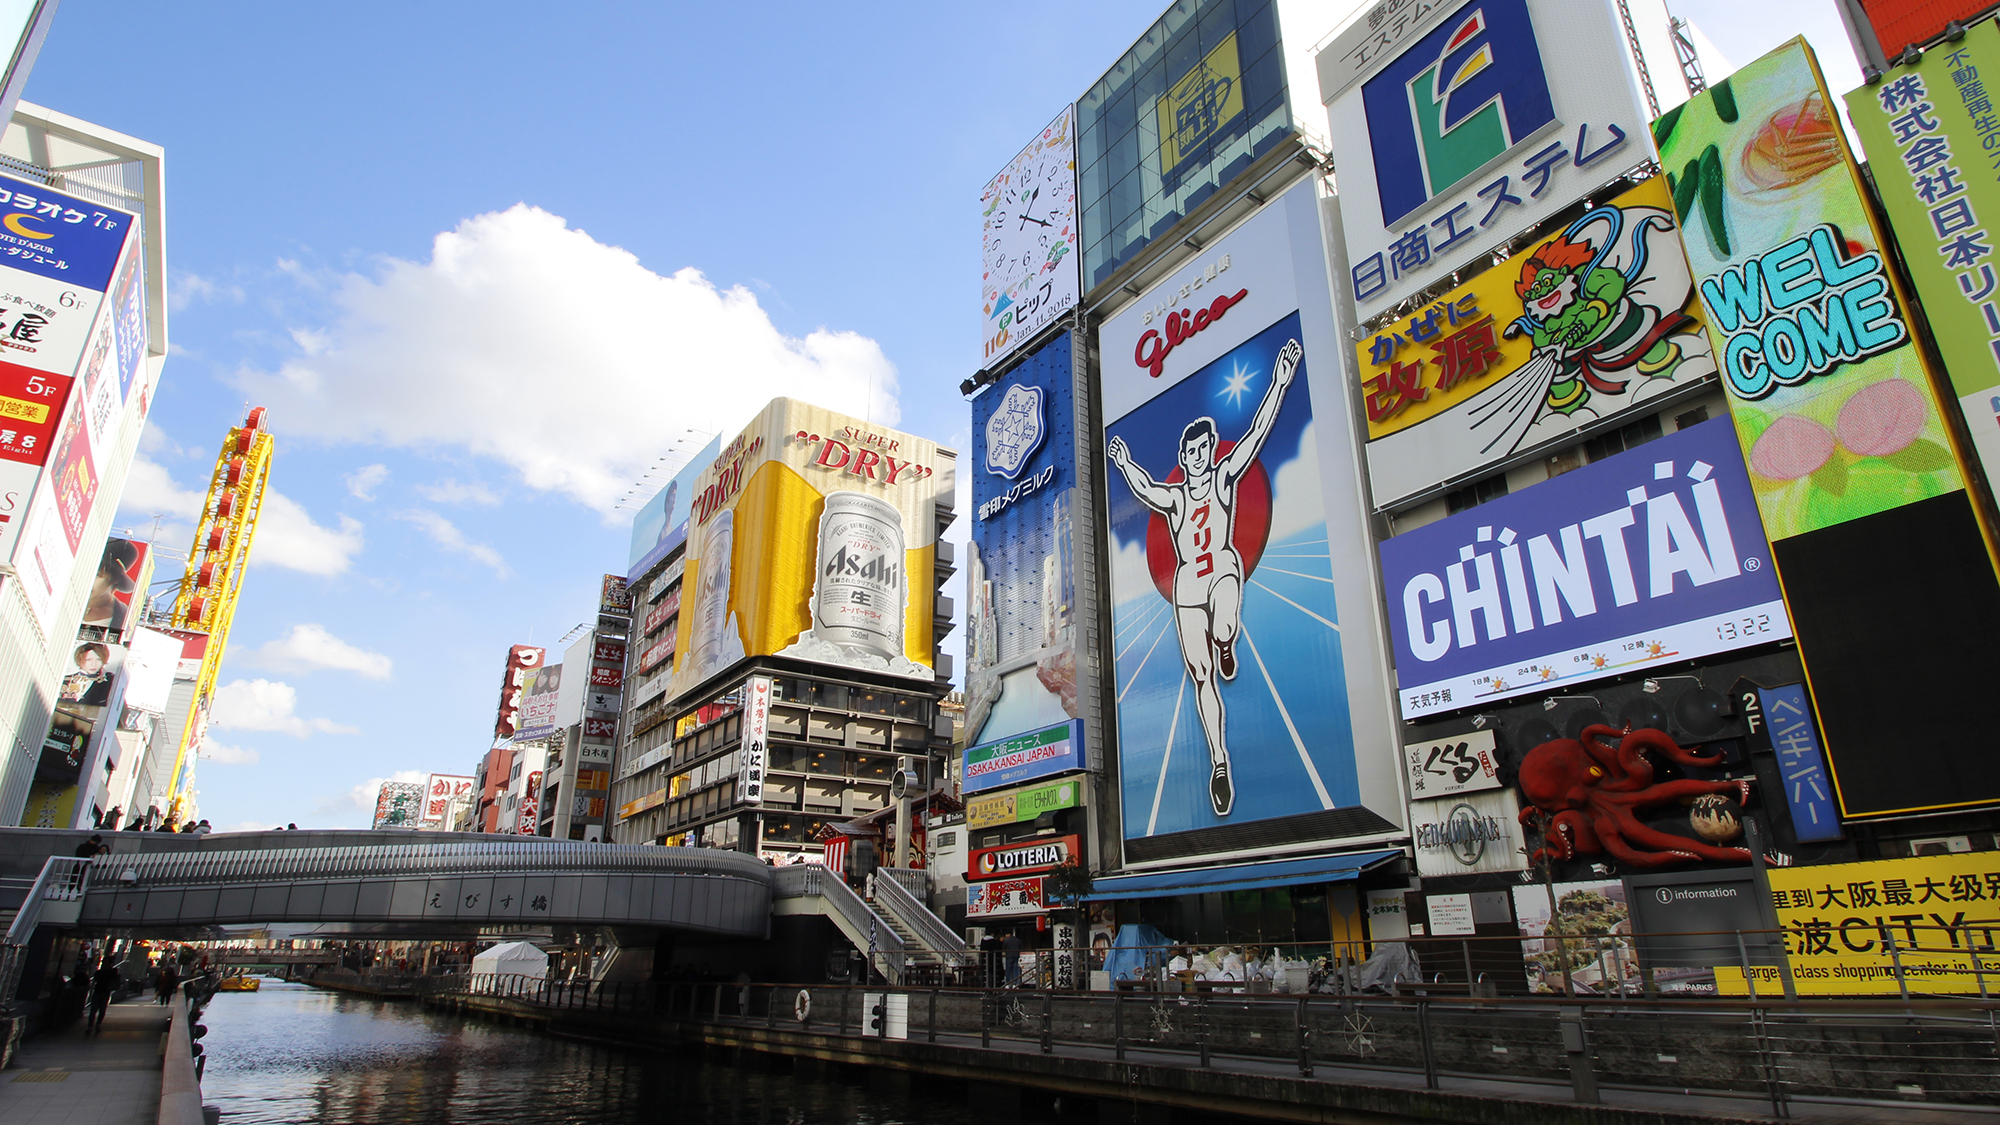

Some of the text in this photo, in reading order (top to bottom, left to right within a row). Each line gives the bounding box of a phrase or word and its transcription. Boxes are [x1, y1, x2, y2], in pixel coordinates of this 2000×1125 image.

[1354, 0, 1447, 70] エステム
[1020, 169, 1032, 188] 12
[1038, 162, 1044, 177] 1
[1047, 165, 1058, 182] 2
[1006, 189, 1016, 205] 11
[1052, 182, 1063, 197] 3
[93, 211, 118, 231] 7F
[995, 211, 1006, 229] 10
[1049, 208, 1059, 220] 4
[1352, 122, 1628, 302] 日商エステム
[1880, 75, 2000, 370] 株式会社日本リー
[992, 239, 1001, 251] 9
[1038, 233, 1047, 247] 5
[996, 253, 1005, 268] 8
[1008, 259, 1017, 274] 7
[1023, 251, 1030, 266] 6
[1142, 253, 1231, 326] おいしさと健康
[1701, 229, 1878, 332] WEL
[1016, 278, 1053, 325] ピップ
[1047, 293, 1071, 317] 2018
[0, 308, 49, 344] 屋
[1135, 288, 1248, 378] Glico
[1368, 292, 1482, 366] かぜに
[1725, 279, 1901, 394] COME
[1362, 312, 1504, 423] 改源
[25, 375, 57, 397] 5F
[843, 425, 900, 453] SUPER
[713, 434, 745, 477] SUPER
[978, 465, 1054, 521] 雪印メグミルク
[1190, 498, 1214, 579] グリコ
[825, 545, 897, 590] Asahi
[1403, 459, 1741, 663] CHINTAI
[851, 591, 872, 607] 生
[840, 606, 882, 620] スーパードライ
[850, 630, 869, 641] 350ml
[1622, 640, 1645, 653] 12時
[1573, 653, 1589, 664] 6時
[1518, 664, 1538, 676] 24時
[1472, 676, 1490, 687] 18時
[1409, 688, 1453, 710] 天気予報
[520, 702, 557, 718] いちごナ
[755, 696, 765, 736] 本場の味
[1742, 692, 1761, 734] 2F
[586, 721, 615, 736] はや
[582, 746, 609, 758] 白木屋
[990, 733, 1042, 759] 大阪ニュース
[1026, 745, 1056, 763] JAPAN
[1423, 741, 1480, 785] くくる
[1770, 696, 1825, 825] ペンギンバー
[432, 779, 471, 796] かに
[519, 797, 537, 835] 大阪
[997, 845, 1059, 868] LOTTERIA
[430, 893, 548, 911] えびす橋
[1674, 887, 1738, 900] information
[1741, 965, 1782, 982] Larges
[1794, 965, 1830, 979] class
